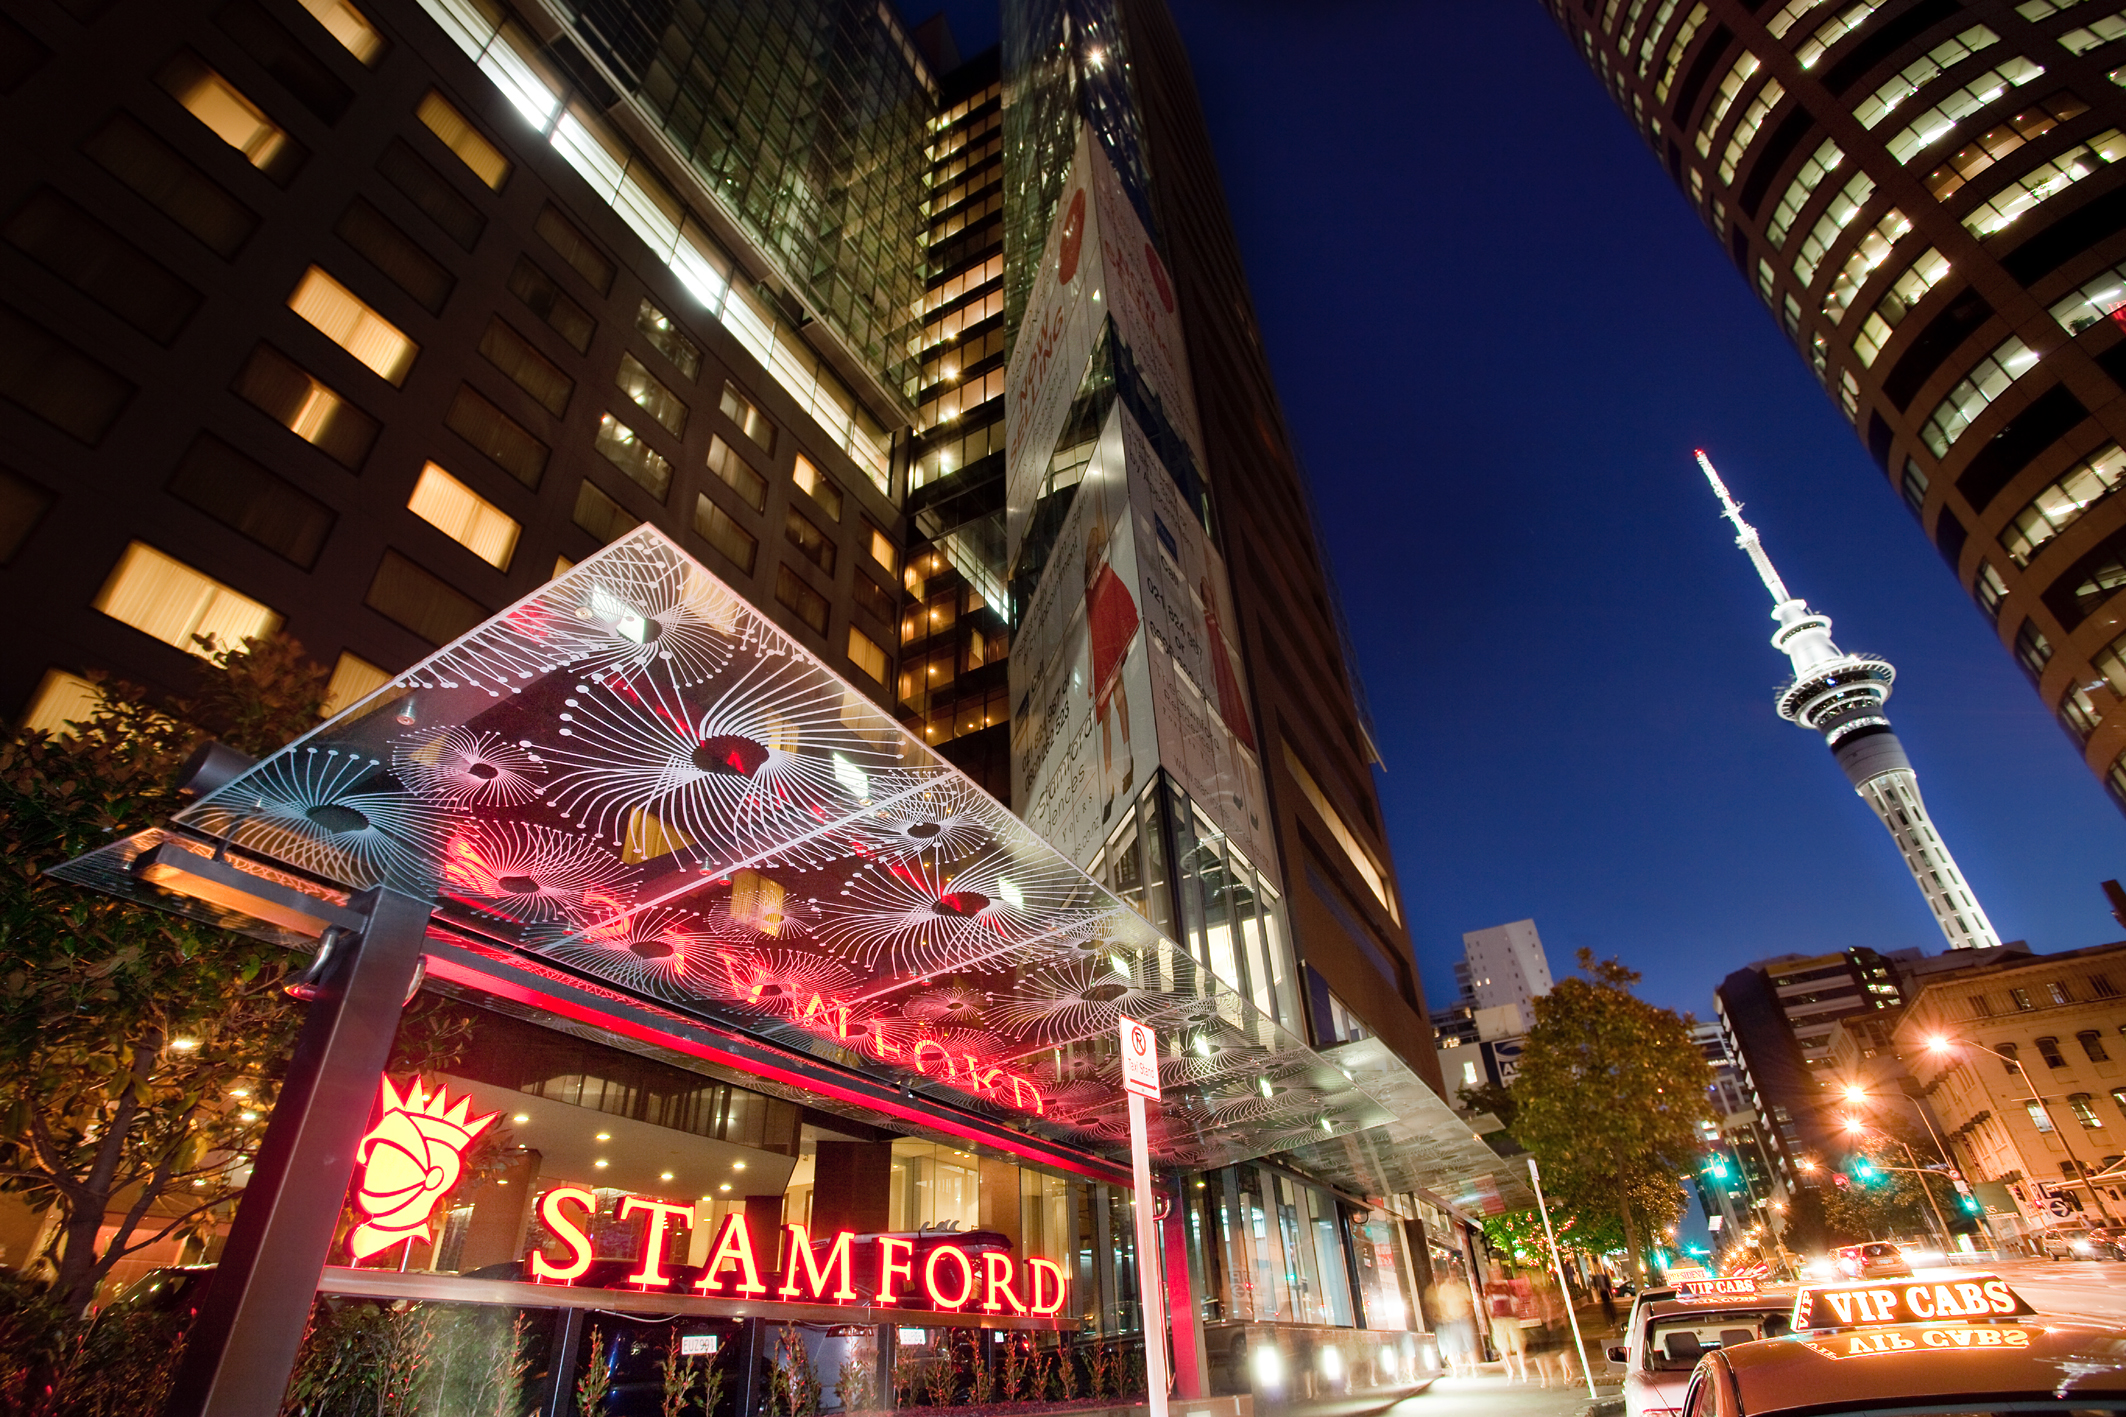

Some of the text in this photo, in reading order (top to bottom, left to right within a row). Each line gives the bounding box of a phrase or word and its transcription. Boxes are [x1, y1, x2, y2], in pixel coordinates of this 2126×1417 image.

[1019, 308, 1049, 415] NOW
[1010, 305, 1064, 471] SELLING
[1161, 555, 1180, 588] Call
[1147, 577, 1166, 611] 021
[1175, 635, 1185, 654] or
[1031, 659, 1044, 693] Call
[1062, 670, 1071, 695] or
[1056, 699, 1070, 736] 523
[1038, 706, 1095, 820] Stamford
[1128, 1057, 1155, 1079] Taxi Stand
[1984, 1204, 1998, 1215] 35
[531, 1186, 1068, 1315] STAMFORD
[1667, 1270, 1706, 1281] PRESIDENT
[1686, 1281, 1714, 1295] VIP
[1716, 1279, 1756, 1294] CABS
[1825, 1281, 2017, 1324] VIP CABS
